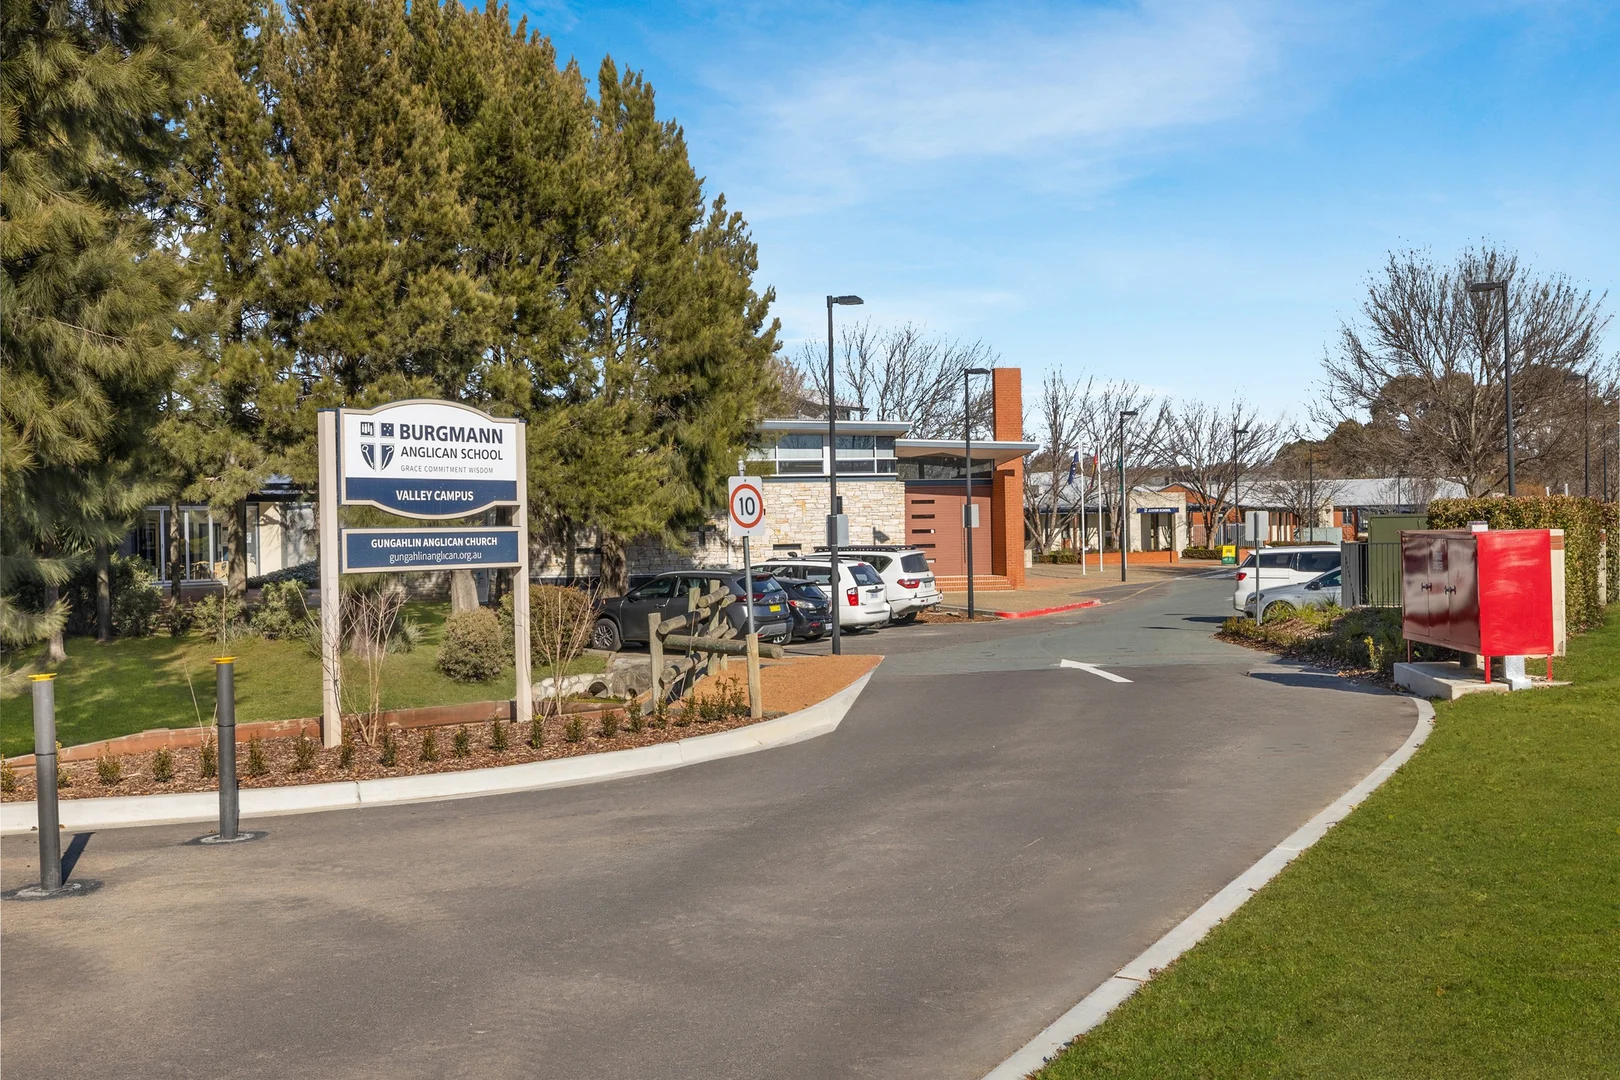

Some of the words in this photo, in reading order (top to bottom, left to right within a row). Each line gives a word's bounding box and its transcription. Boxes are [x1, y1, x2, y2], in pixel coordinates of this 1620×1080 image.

[400, 424, 502, 444] BURGMANN
[401, 446, 458, 458] ANGLICAN
[461, 449, 503, 460] SCHOOL
[396, 490, 432, 500] VALLEY
[434, 490, 474, 501] CAMPUS
[739, 496, 755, 516] 10
[371, 539, 422, 548] GUNGAHLIN
[423, 538, 463, 546] ANGLICAN
[465, 537, 498, 546] CHURCH
[390, 551, 482, 564] gungahlinanglican.org.au
